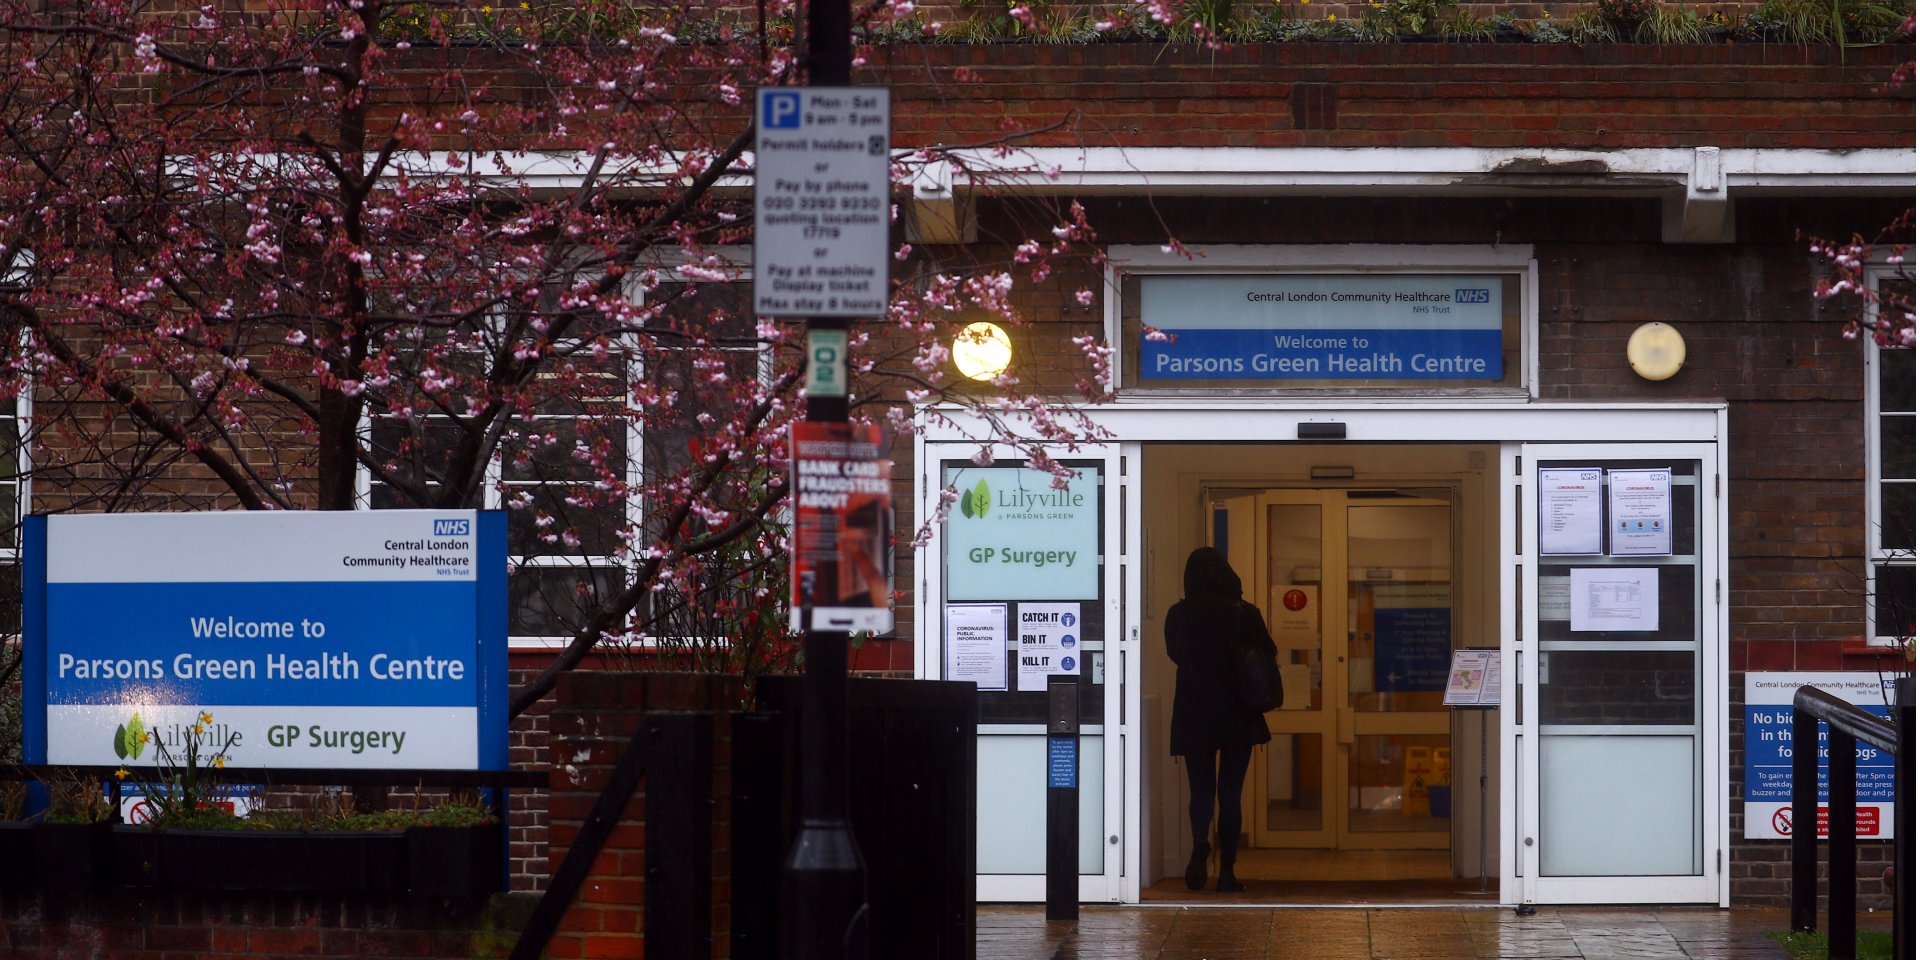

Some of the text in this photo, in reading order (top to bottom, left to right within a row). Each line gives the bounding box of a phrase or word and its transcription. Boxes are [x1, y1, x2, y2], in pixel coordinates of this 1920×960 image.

[811, 96, 841, 108] Mon
[853, 96, 877, 108] Sat
[772, 96, 795, 126] P
[762, 138, 808, 150] Permit
[812, 138, 865, 150] holders
[814, 162, 830, 173] or
[776, 179, 869, 193] Pay by phone
[764, 213, 879, 226] quoting location
[813, 248, 828, 258] or
[768, 264, 875, 279] Pay at machine
[772, 279, 870, 294] Display ticket
[760, 297, 789, 309] Max
[794, 297, 822, 311] stay
[842, 297, 882, 309] hours
[1247, 290, 1488, 304] Central London Community Healthcare NHS
[1412, 306, 1450, 314] NHS Trust
[1274, 335, 1369, 349] Welcome to
[1156, 352, 1486, 372] Parsons Green Health Centre
[798, 460, 880, 478] BANK CARD
[798, 476, 890, 494] FRAUDSTERS
[799, 492, 849, 509] ABOUT
[998, 489, 1084, 512] Lilyville
[435, 520, 468, 535] NHS
[384, 539, 469, 552] Central London
[343, 554, 469, 569] Community Healthcare
[969, 548, 1077, 568] GP Surgery
[436, 568, 470, 576] NHS Trust
[1022, 612, 1059, 622] CATCH IT
[191, 616, 325, 638] Welcome to
[1022, 634, 1046, 644] BIN IT
[59, 652, 464, 680] Parsons Green Health Centre
[1022, 656, 1050, 666] KILL IT
[1754, 712, 1772, 724] No
[268, 725, 300, 748] GP
[309, 725, 406, 754] Surgery
[1761, 728, 1792, 740] in th
[1778, 746, 1876, 760] fo ogs
